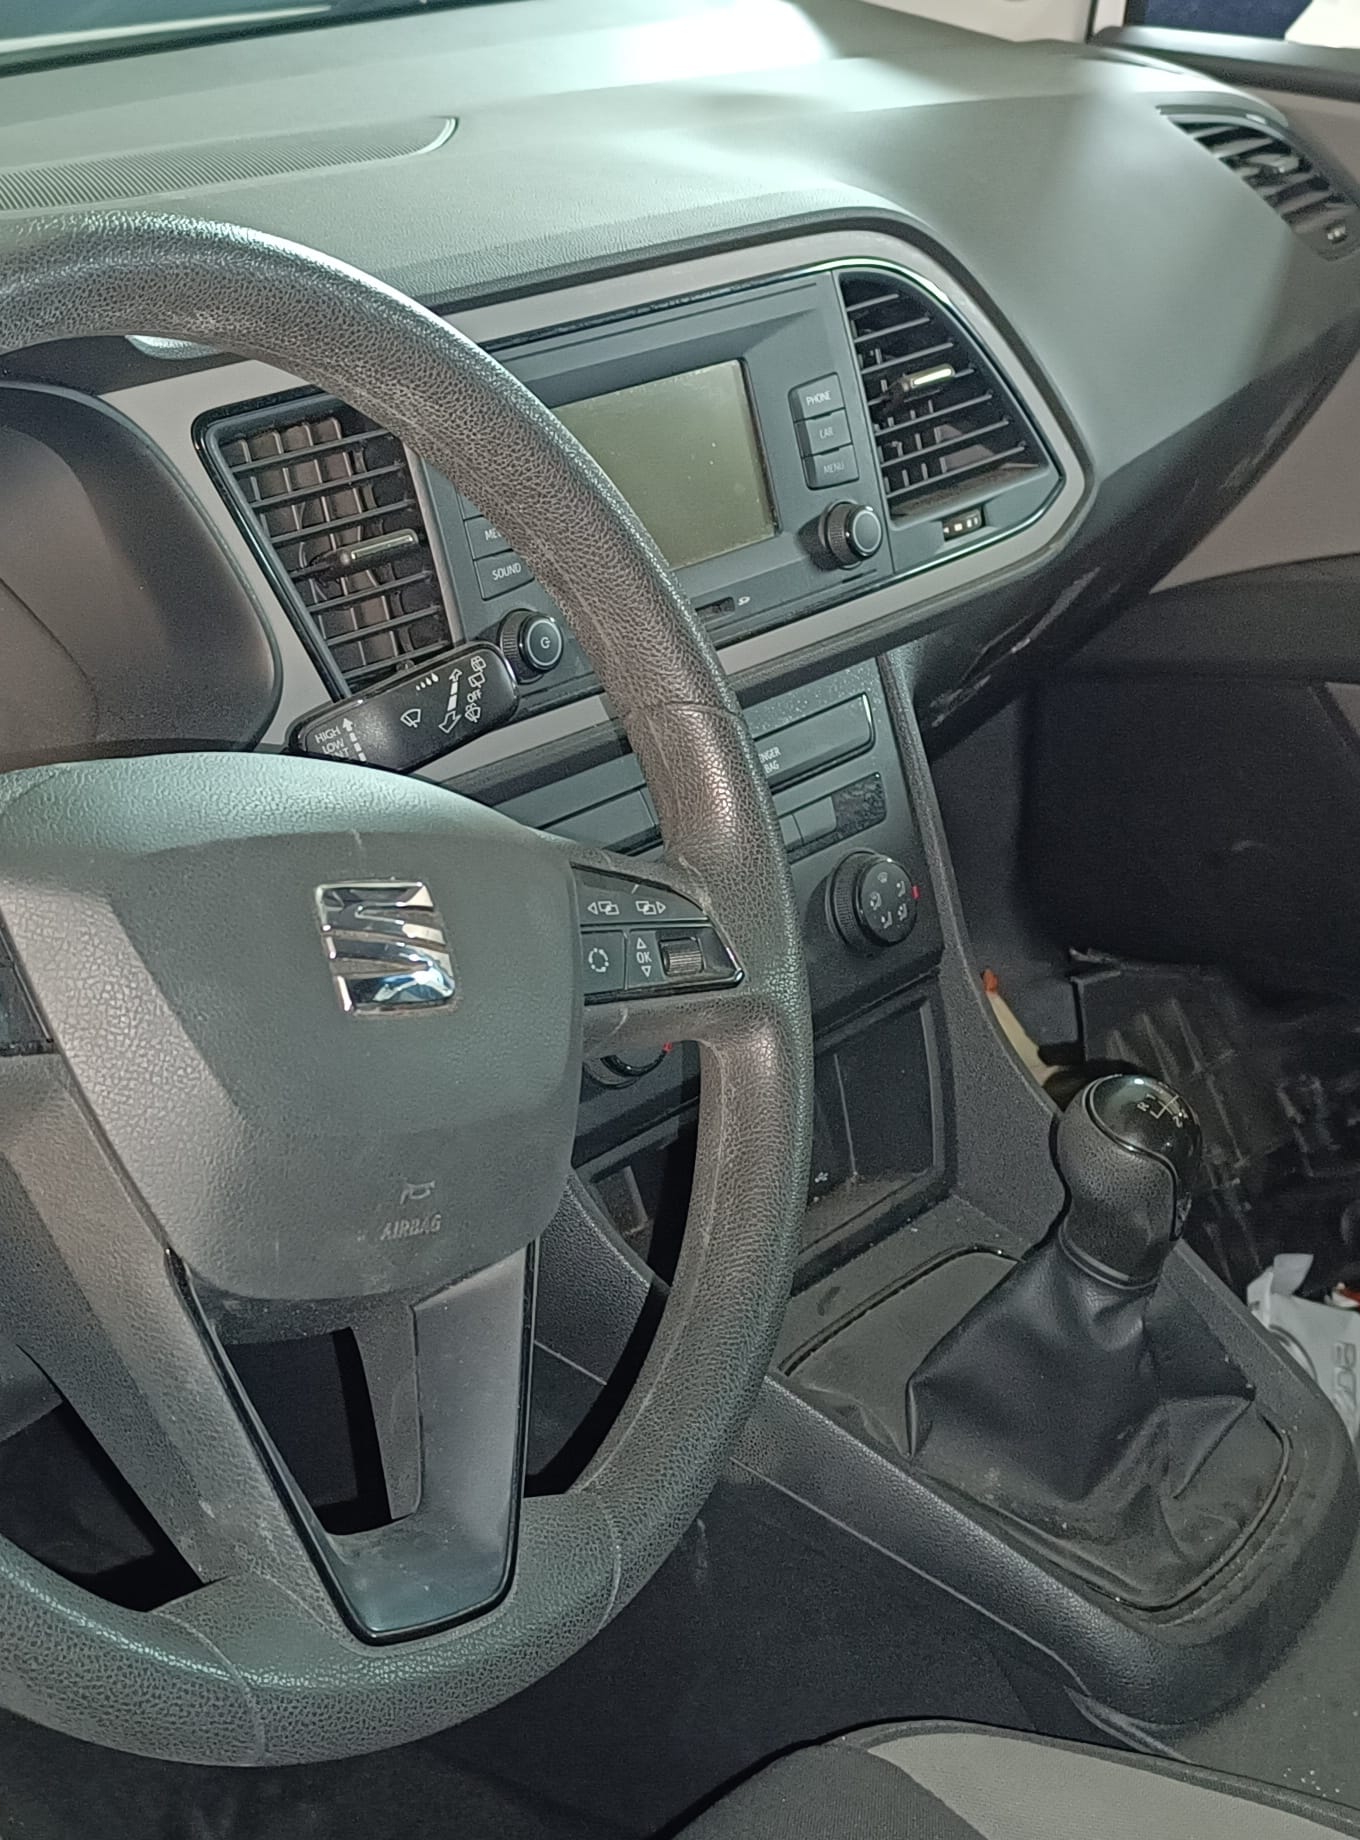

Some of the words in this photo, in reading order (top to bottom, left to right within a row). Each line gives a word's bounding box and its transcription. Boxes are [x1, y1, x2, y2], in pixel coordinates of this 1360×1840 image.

[805, 390, 831, 406] PHONE
[819, 426, 834, 439] CAR
[823, 462, 845, 474] MENU
[484, 528, 502, 541] ME
[492, 562, 522, 581] SOUND
[467, 690, 483, 704] OFF
[314, 725, 341, 744] HIGH
[322, 738, 345, 755] LOW
[636, 951, 653, 964] OK
[380, 1214, 441, 1241] AIRBAG
